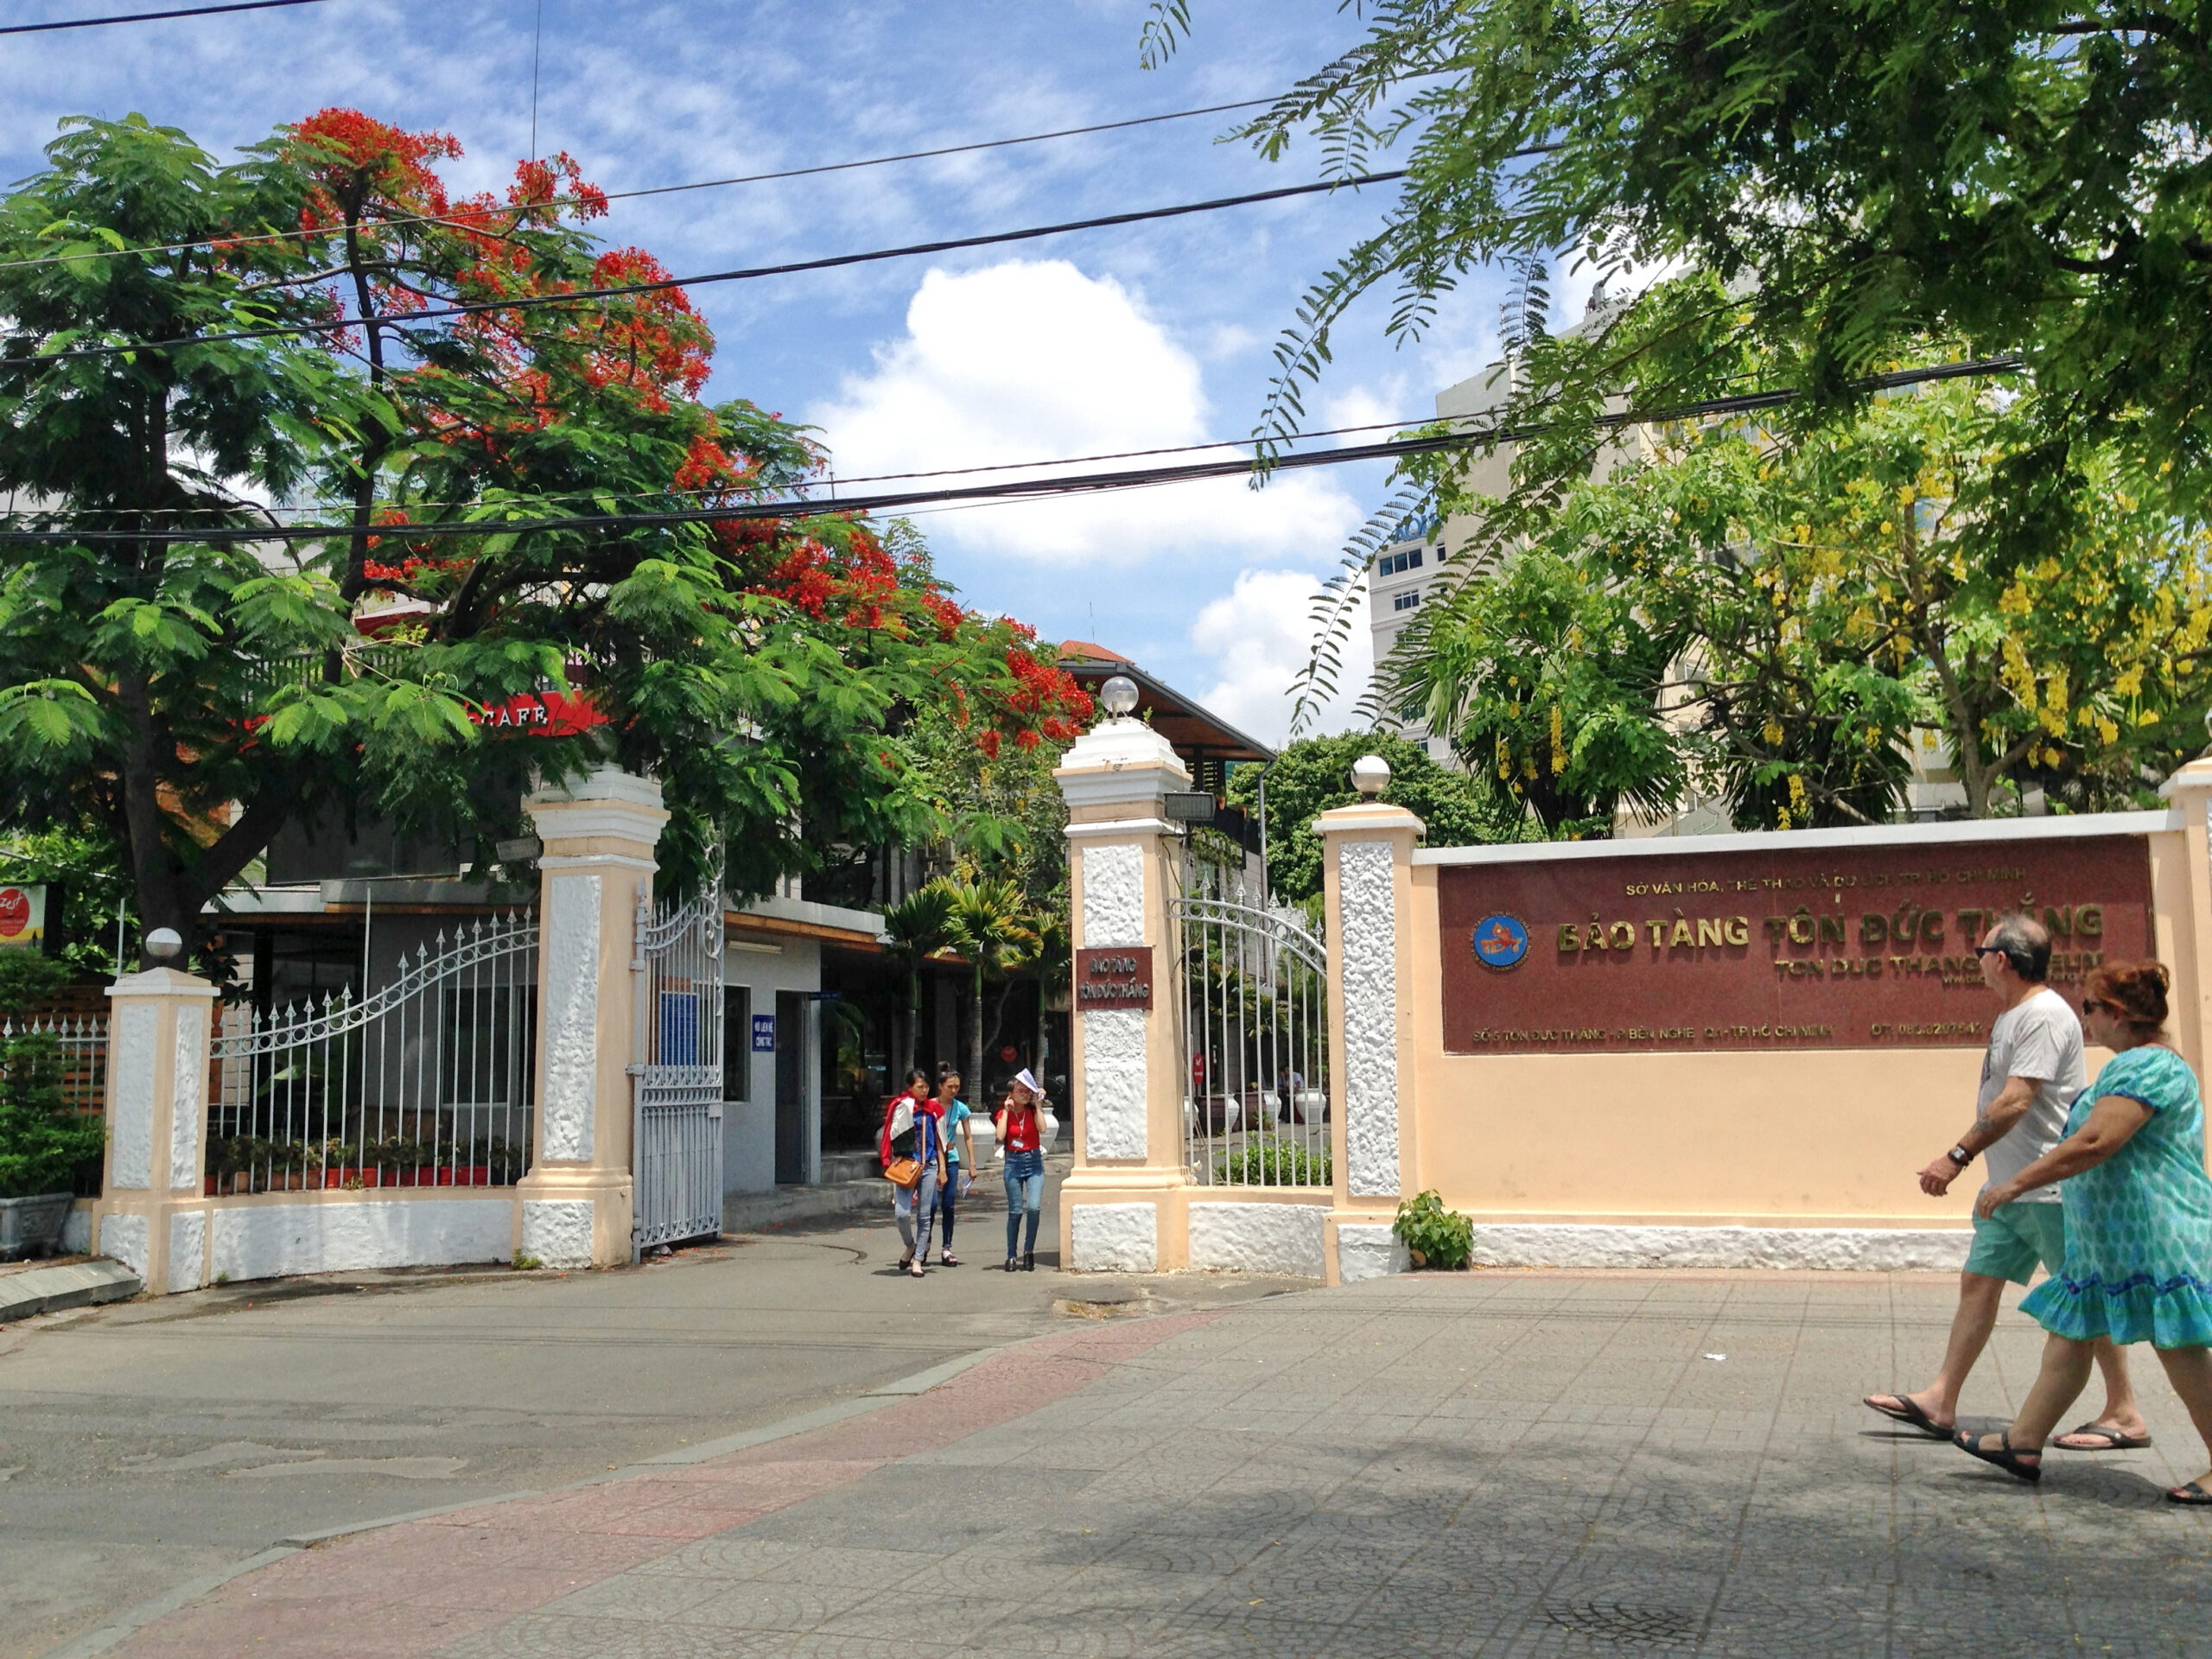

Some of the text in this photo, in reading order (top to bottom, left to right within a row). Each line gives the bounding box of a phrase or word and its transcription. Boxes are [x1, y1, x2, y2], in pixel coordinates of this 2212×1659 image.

[1652, 880, 1683, 895] VĂN
[1987, 868, 2026, 881] MINH
[1558, 912, 1636, 950] BẢO
[1645, 907, 1750, 948] TÀNG
[1764, 905, 1845, 944] TÔN
[1860, 899, 1944, 941] ĐỨC
[1775, 959, 1824, 976] TON
[1832, 957, 1883, 975] DUC
[1890, 953, 1981, 974] THANG
